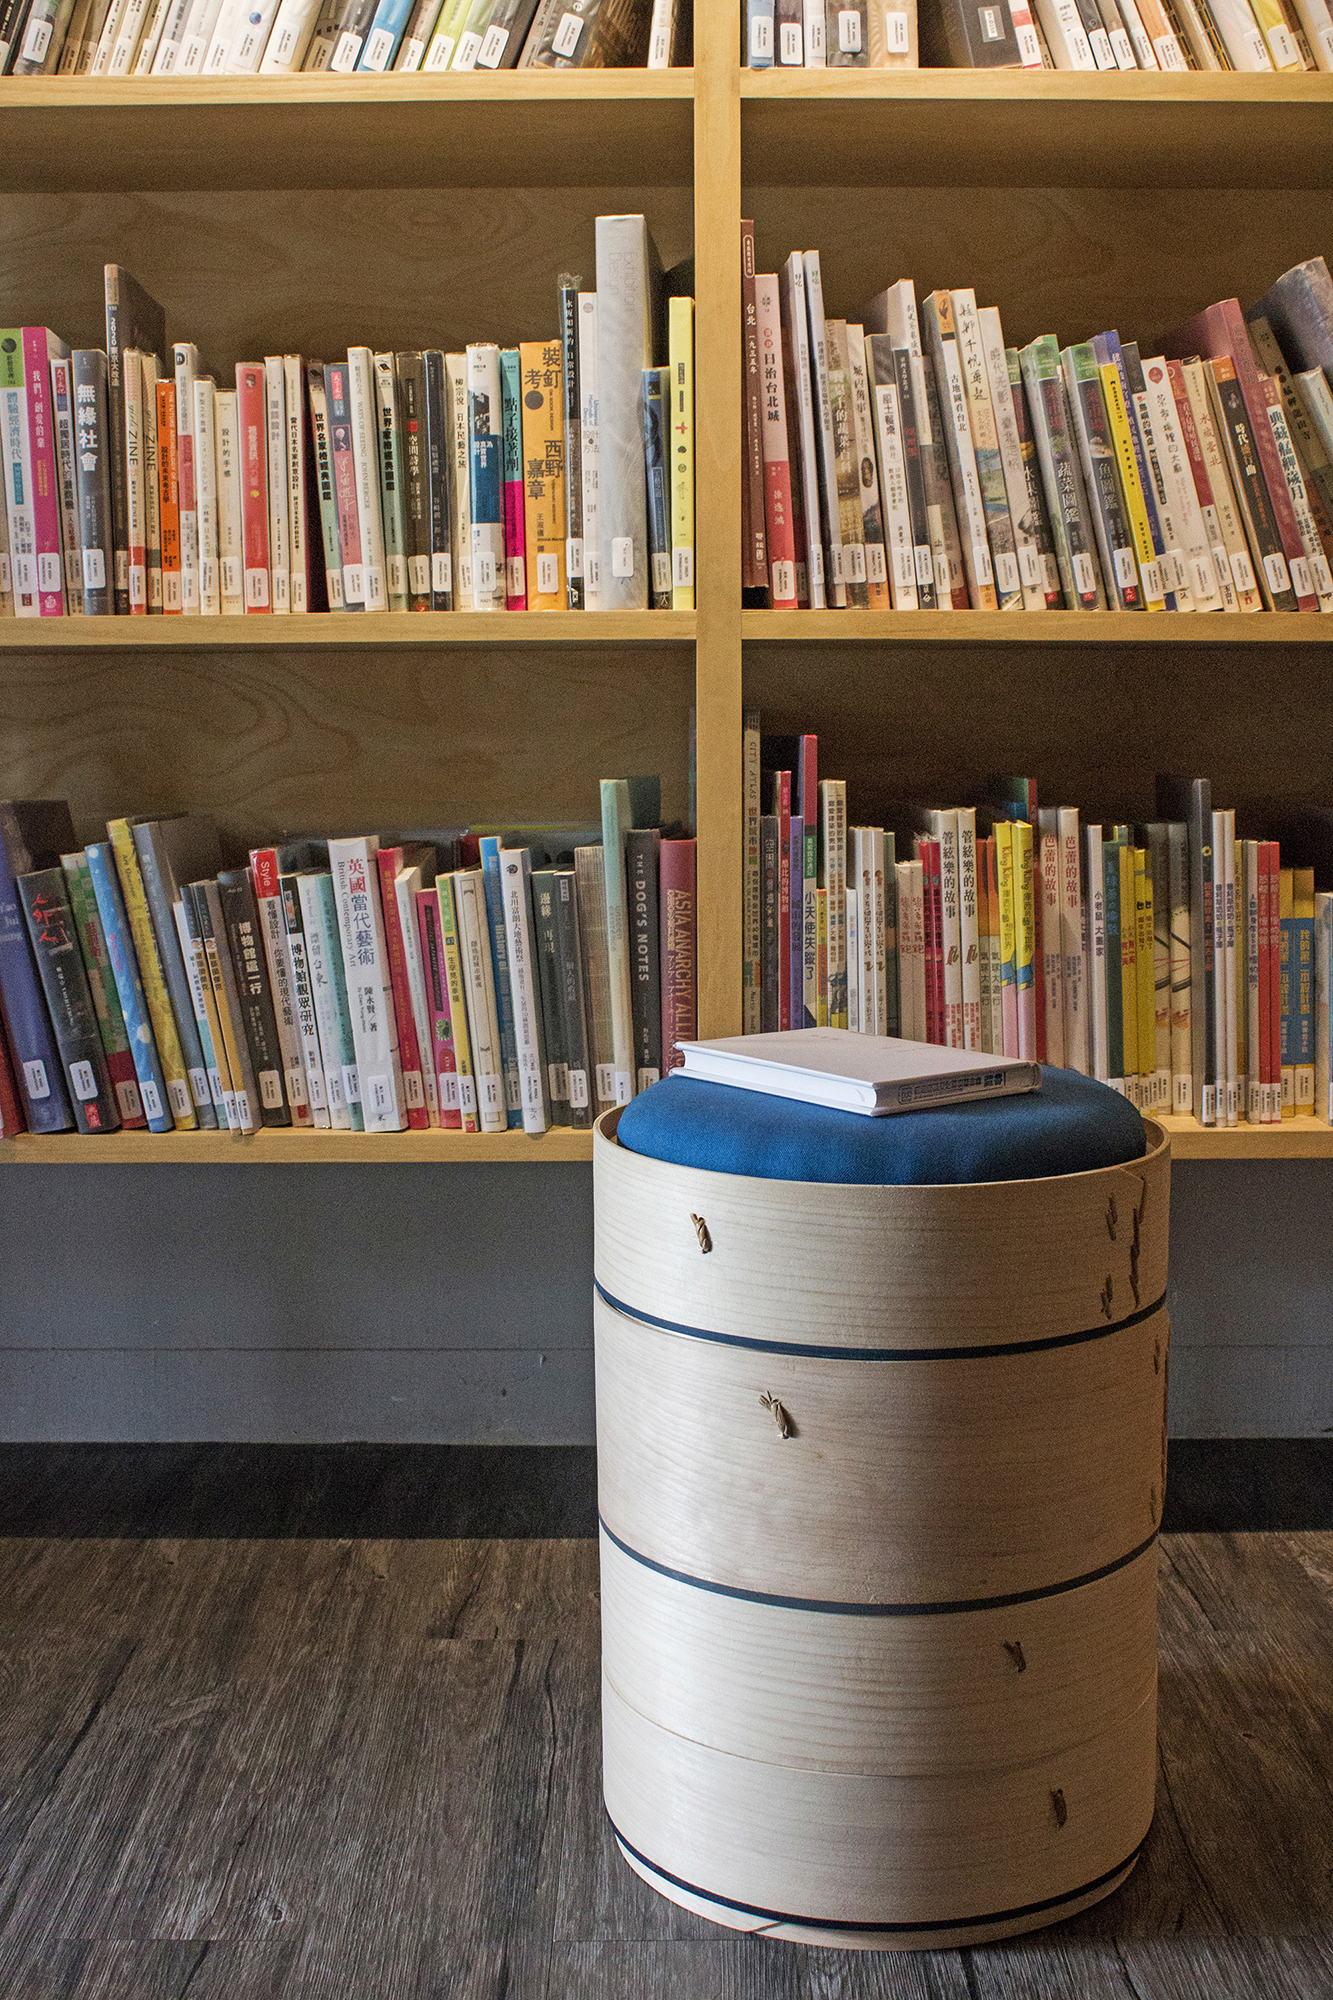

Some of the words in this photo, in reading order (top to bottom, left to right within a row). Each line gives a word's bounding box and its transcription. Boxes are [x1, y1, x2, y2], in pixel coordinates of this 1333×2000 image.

[605, 252, 621, 296] Design
[746, 302, 756, 327] 台北
[542, 346, 561, 389] 裝釘
[747, 335, 758, 375] 一九三五年
[524, 368, 543, 390] 考
[764, 352, 779, 422] 日治台北城
[951, 373, 967, 432] 古地圖看台北
[6, 391, 22, 460] 體驗經濟時代
[77, 383, 98, 472] 無緣社會
[128, 430, 139, 467] ZINE
[146, 434, 157, 471] ZINE
[221, 428, 231, 478] 設計的手感
[544, 439, 563, 479] 西野
[1269, 410, 1304, 501] 典藏艋舺歲月
[526, 458, 546, 500] 嘉章
[1057, 461, 1081, 524] 蔬菜圖鑑
[1098, 463, 1119, 510] 魚圖鑑
[749, 741, 757, 765] CITY
[749, 770, 757, 801] ATLAS
[260, 860, 271, 888] Style
[336, 860, 347, 890] British
[1044, 834, 1057, 907] 芭蕾的故事
[1065, 836, 1078, 908] 芭蕾的故事
[340, 892, 353, 951] Contemporary
[348, 858, 374, 966] 英國當代藝術
[510, 890, 524, 963] 北川富朗大地藝術祭
[635, 880, 648, 927] DOG'S
[674, 888, 692, 927] ASIA
[637, 933, 649, 982] NOTES
[804, 891, 816, 981] 小天使失蹤了
[349, 954, 357, 967] Art
[675, 928, 692, 1000] ANARCHY
[291, 943, 314, 1037] 博物館觀眾研究
